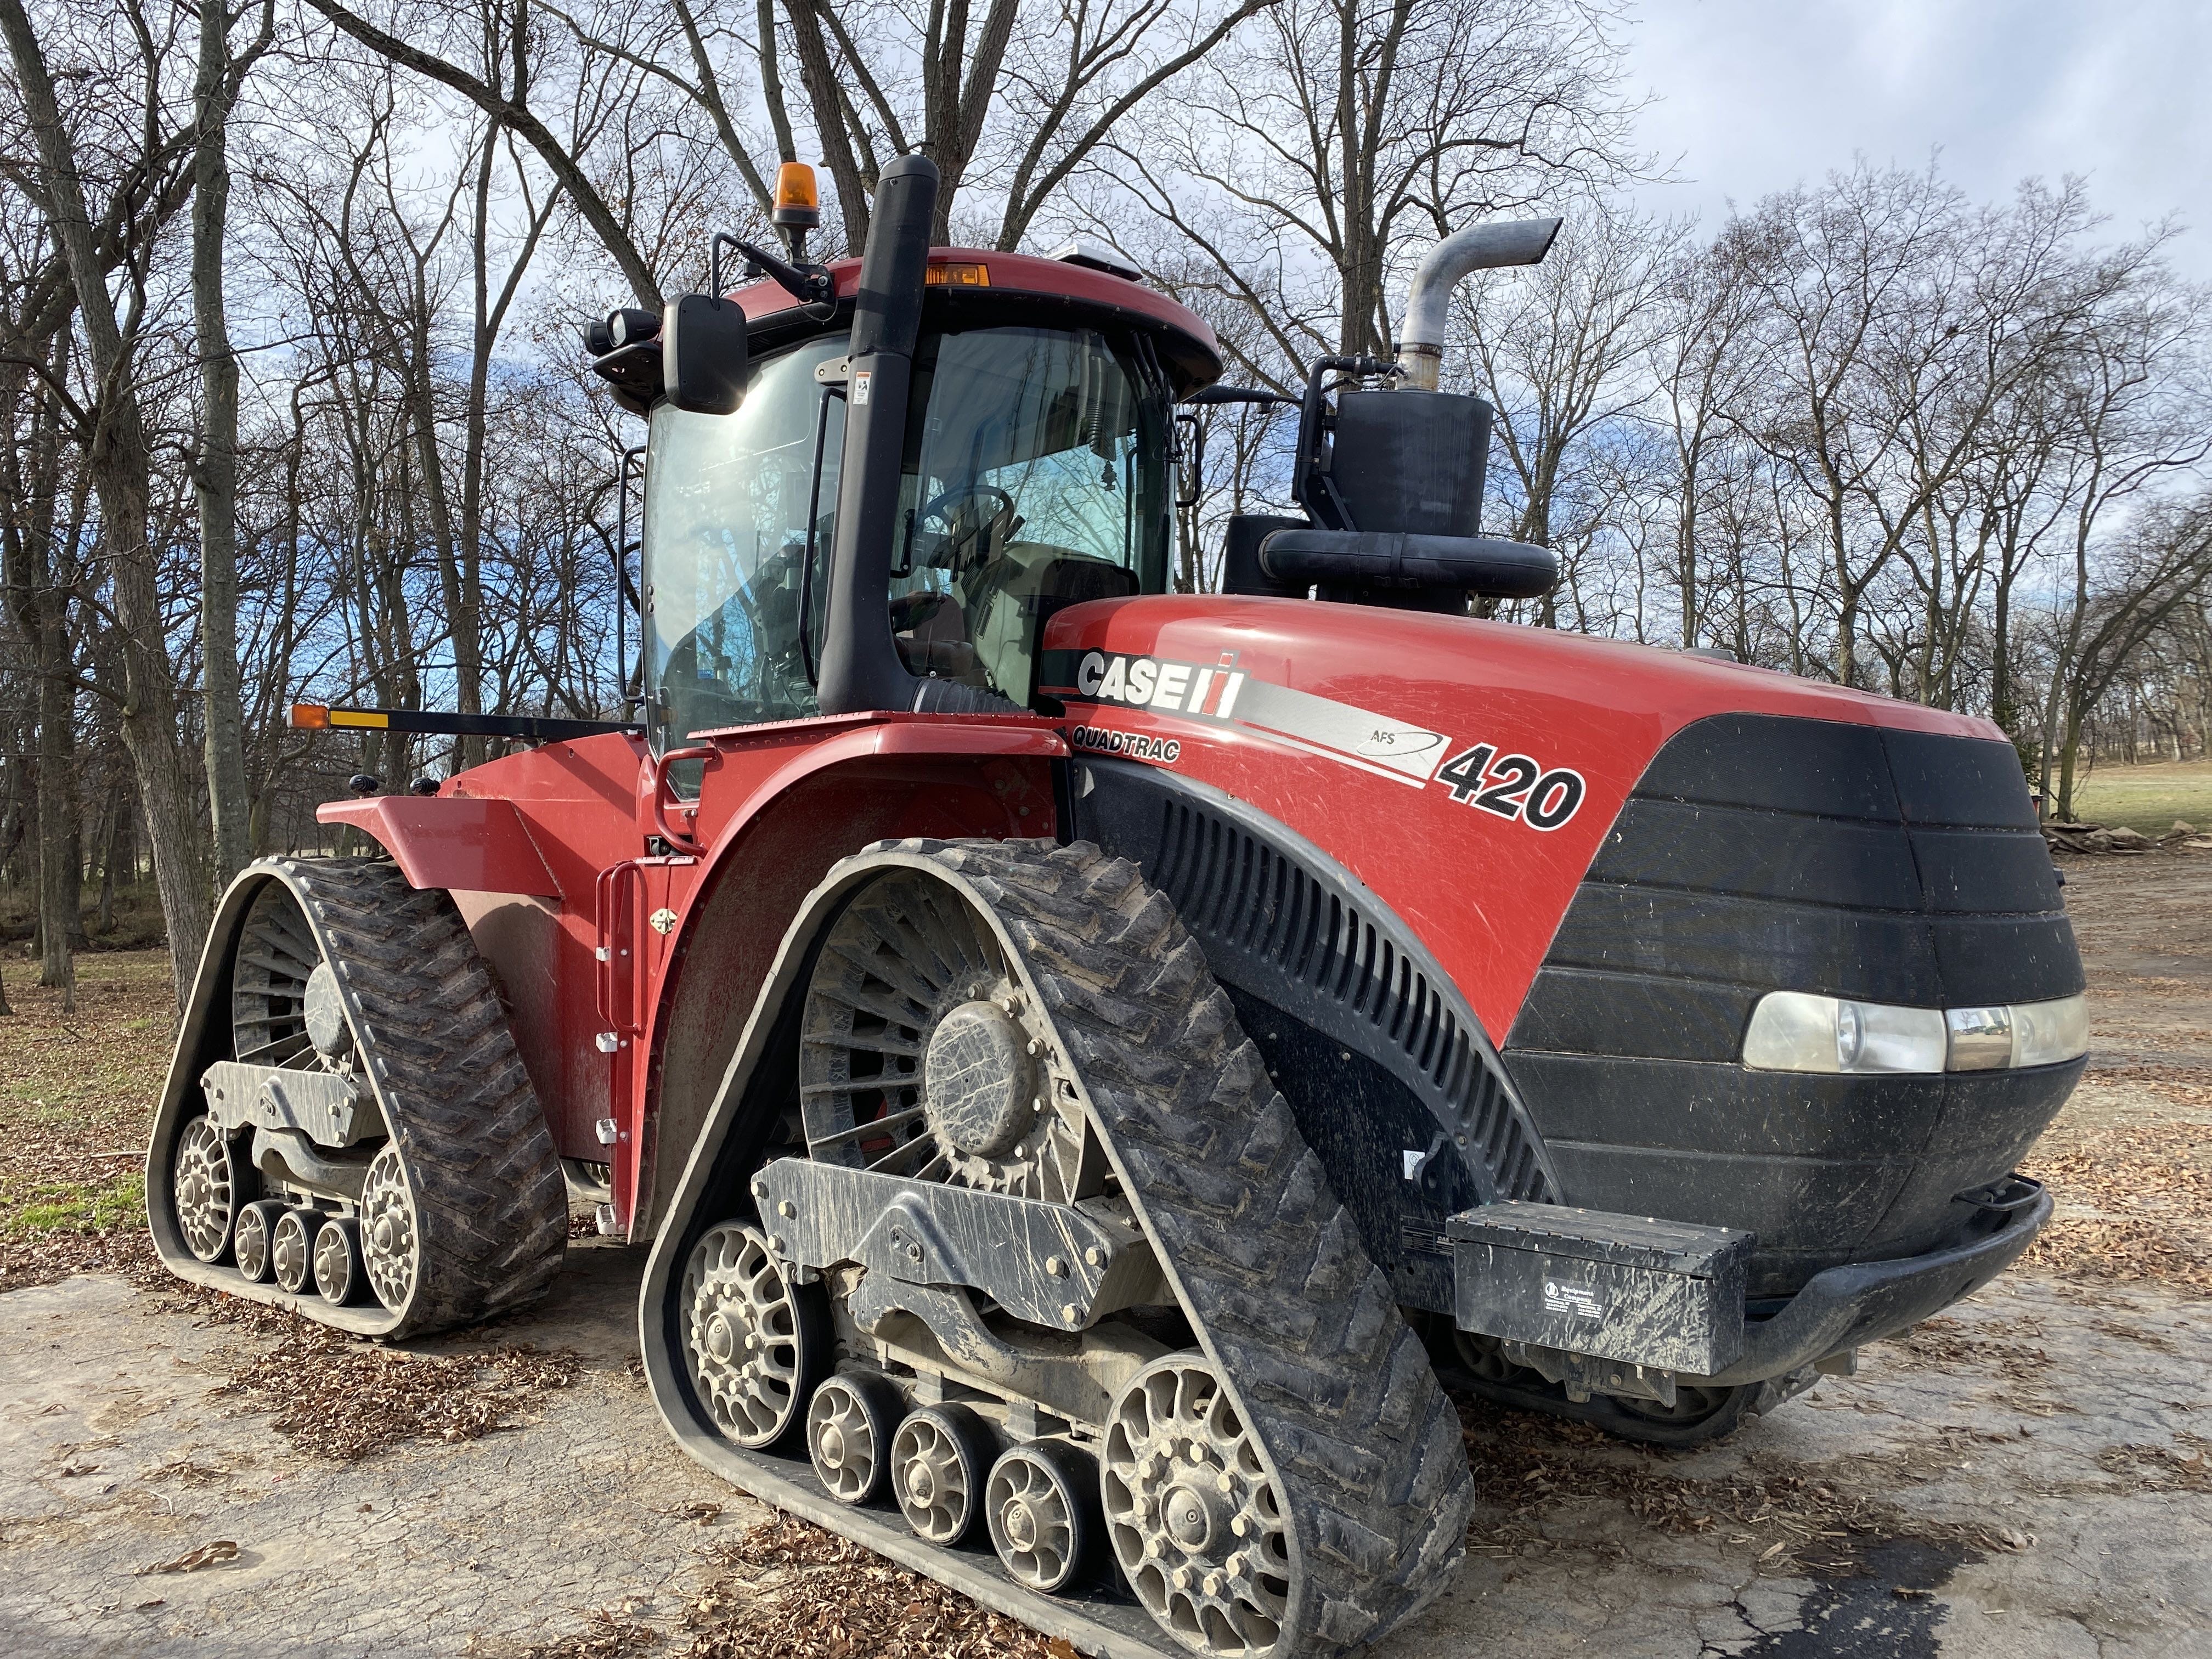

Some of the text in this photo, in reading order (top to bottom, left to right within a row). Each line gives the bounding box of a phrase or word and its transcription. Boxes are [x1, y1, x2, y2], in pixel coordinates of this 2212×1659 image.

[1078, 652, 1192, 709] CASE
[1073, 725, 1180, 763] QUADTRAC
[1371, 730, 1395, 744] AFS
[1433, 742, 1586, 832] 420
[1561, 1285, 1594, 1297] Equipment
[1563, 1294, 1592, 1304] Company
